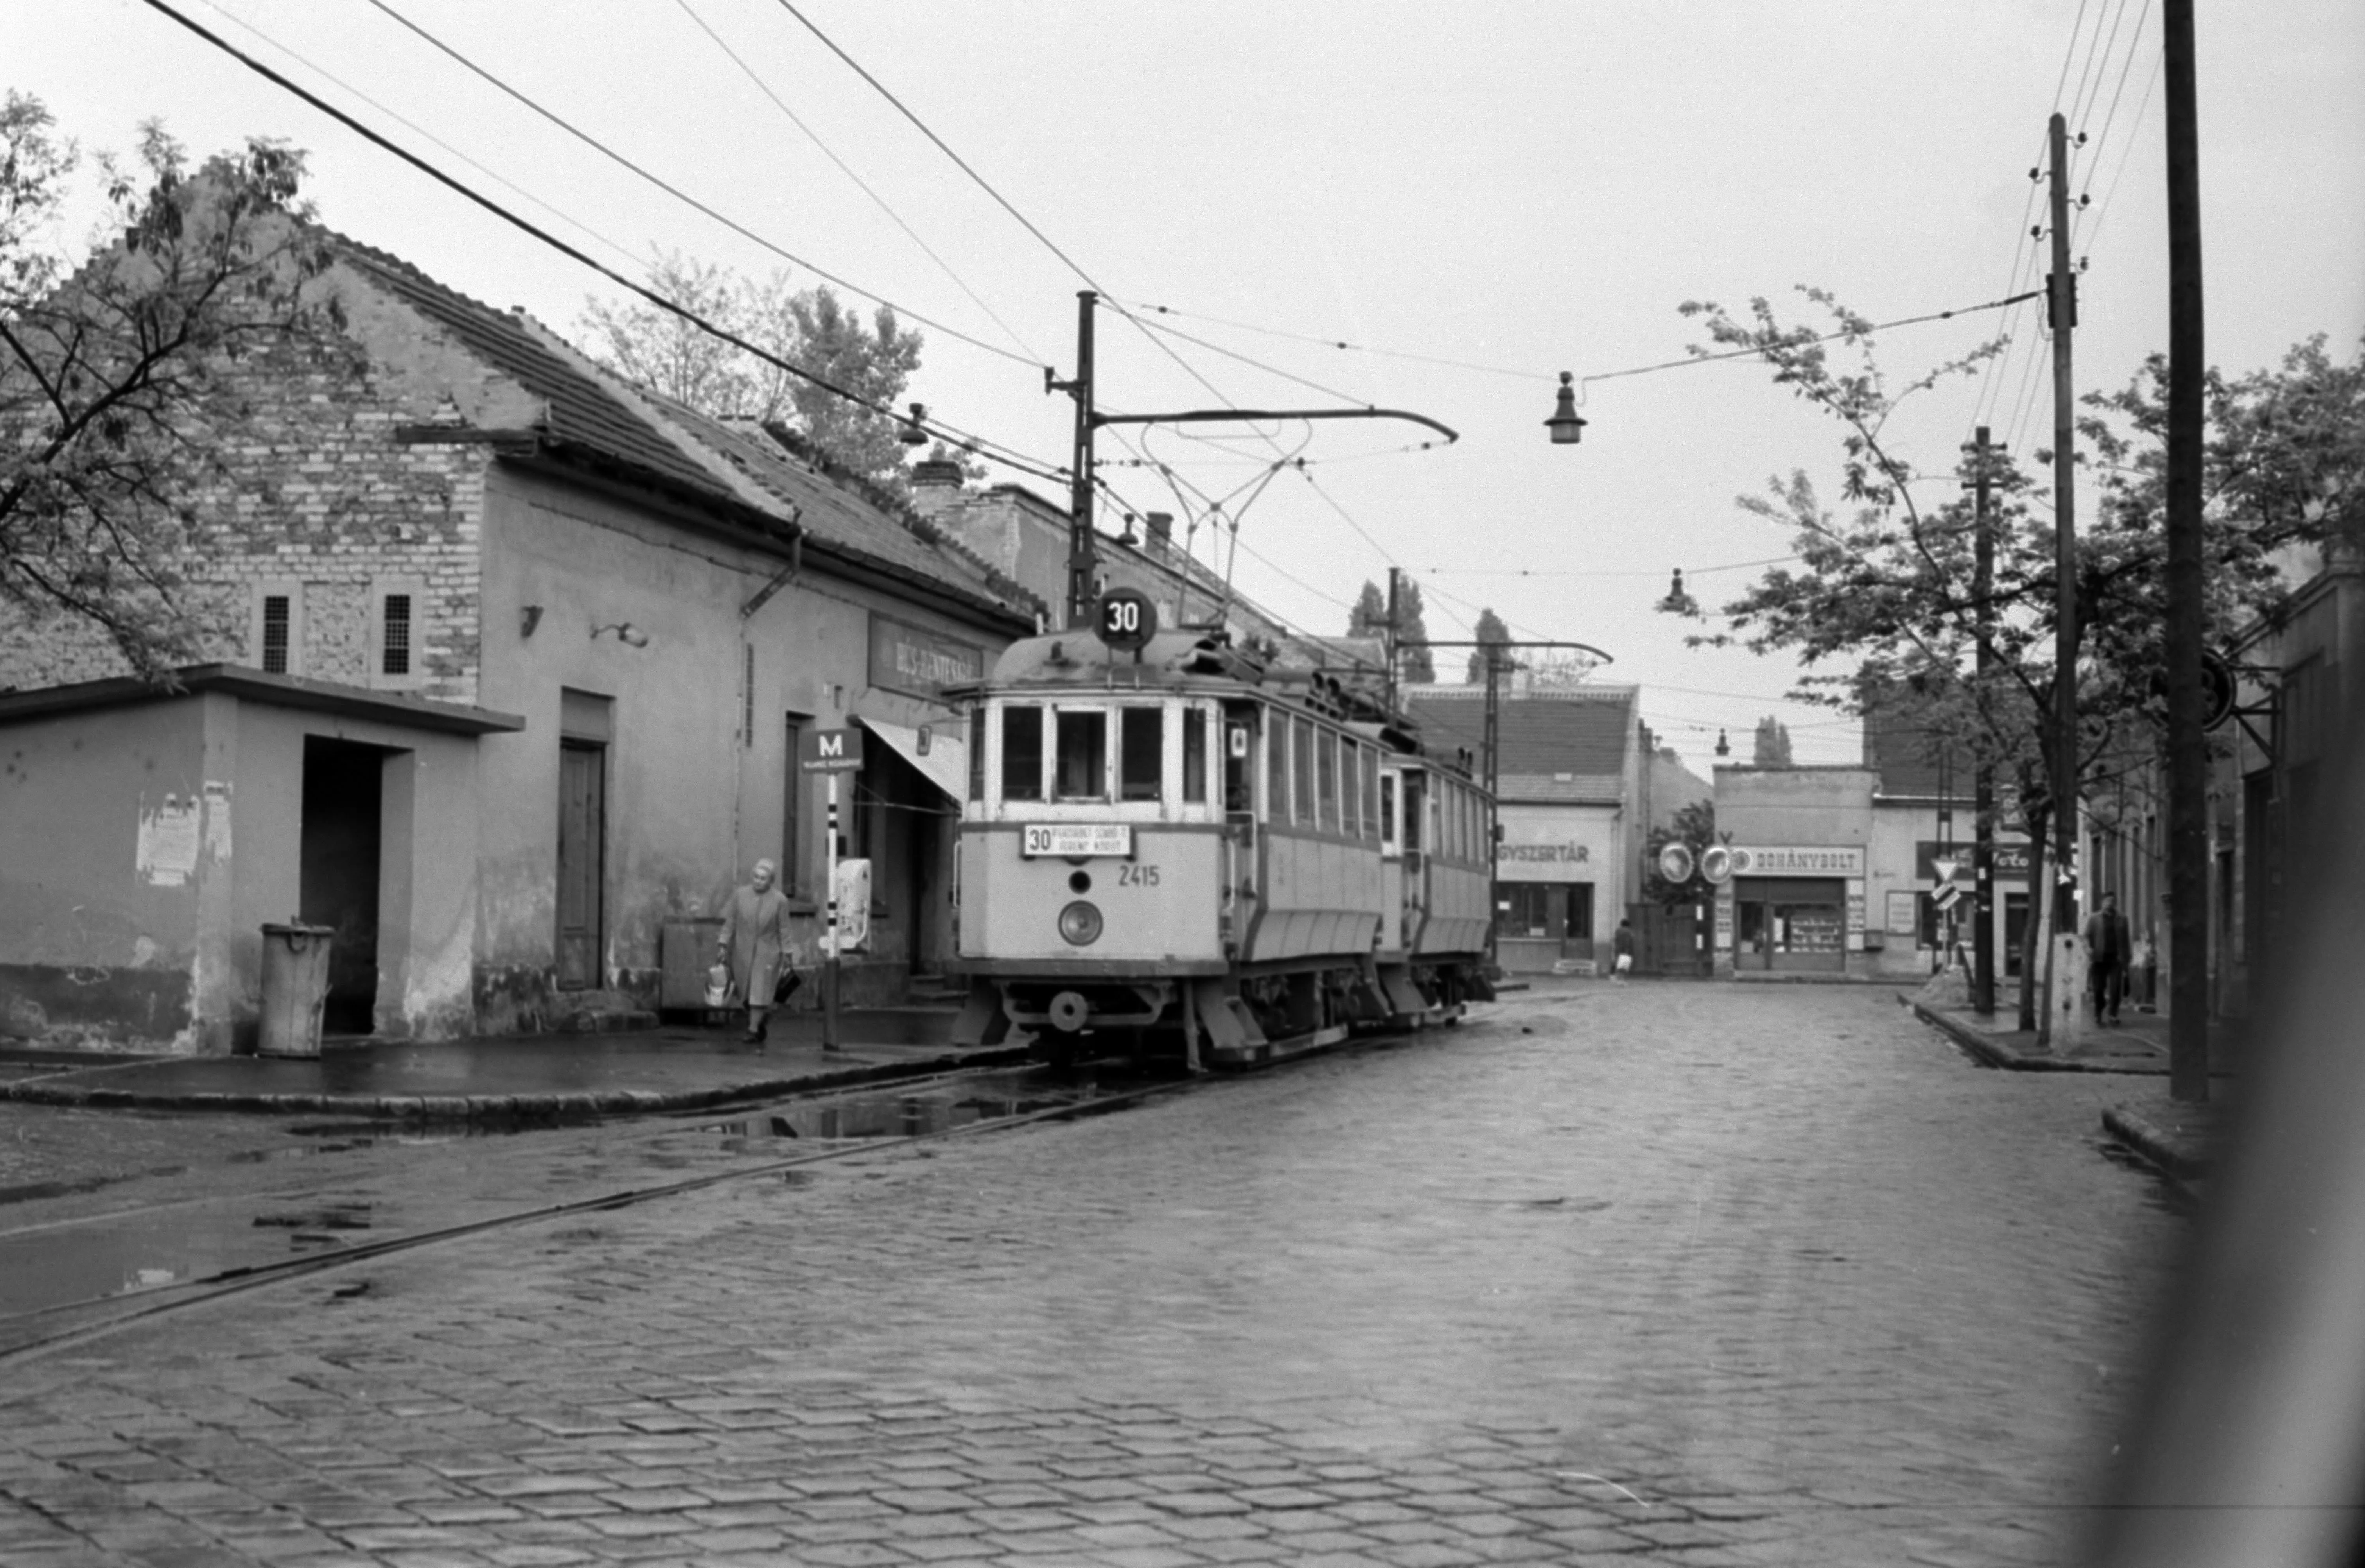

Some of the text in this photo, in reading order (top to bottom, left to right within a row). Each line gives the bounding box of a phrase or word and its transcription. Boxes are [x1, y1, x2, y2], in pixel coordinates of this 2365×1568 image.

[1107, 602, 1138, 632] 30
[820, 735, 842, 756] M
[1029, 829, 1051, 851] 30
[1119, 865, 1160, 887] 2415
